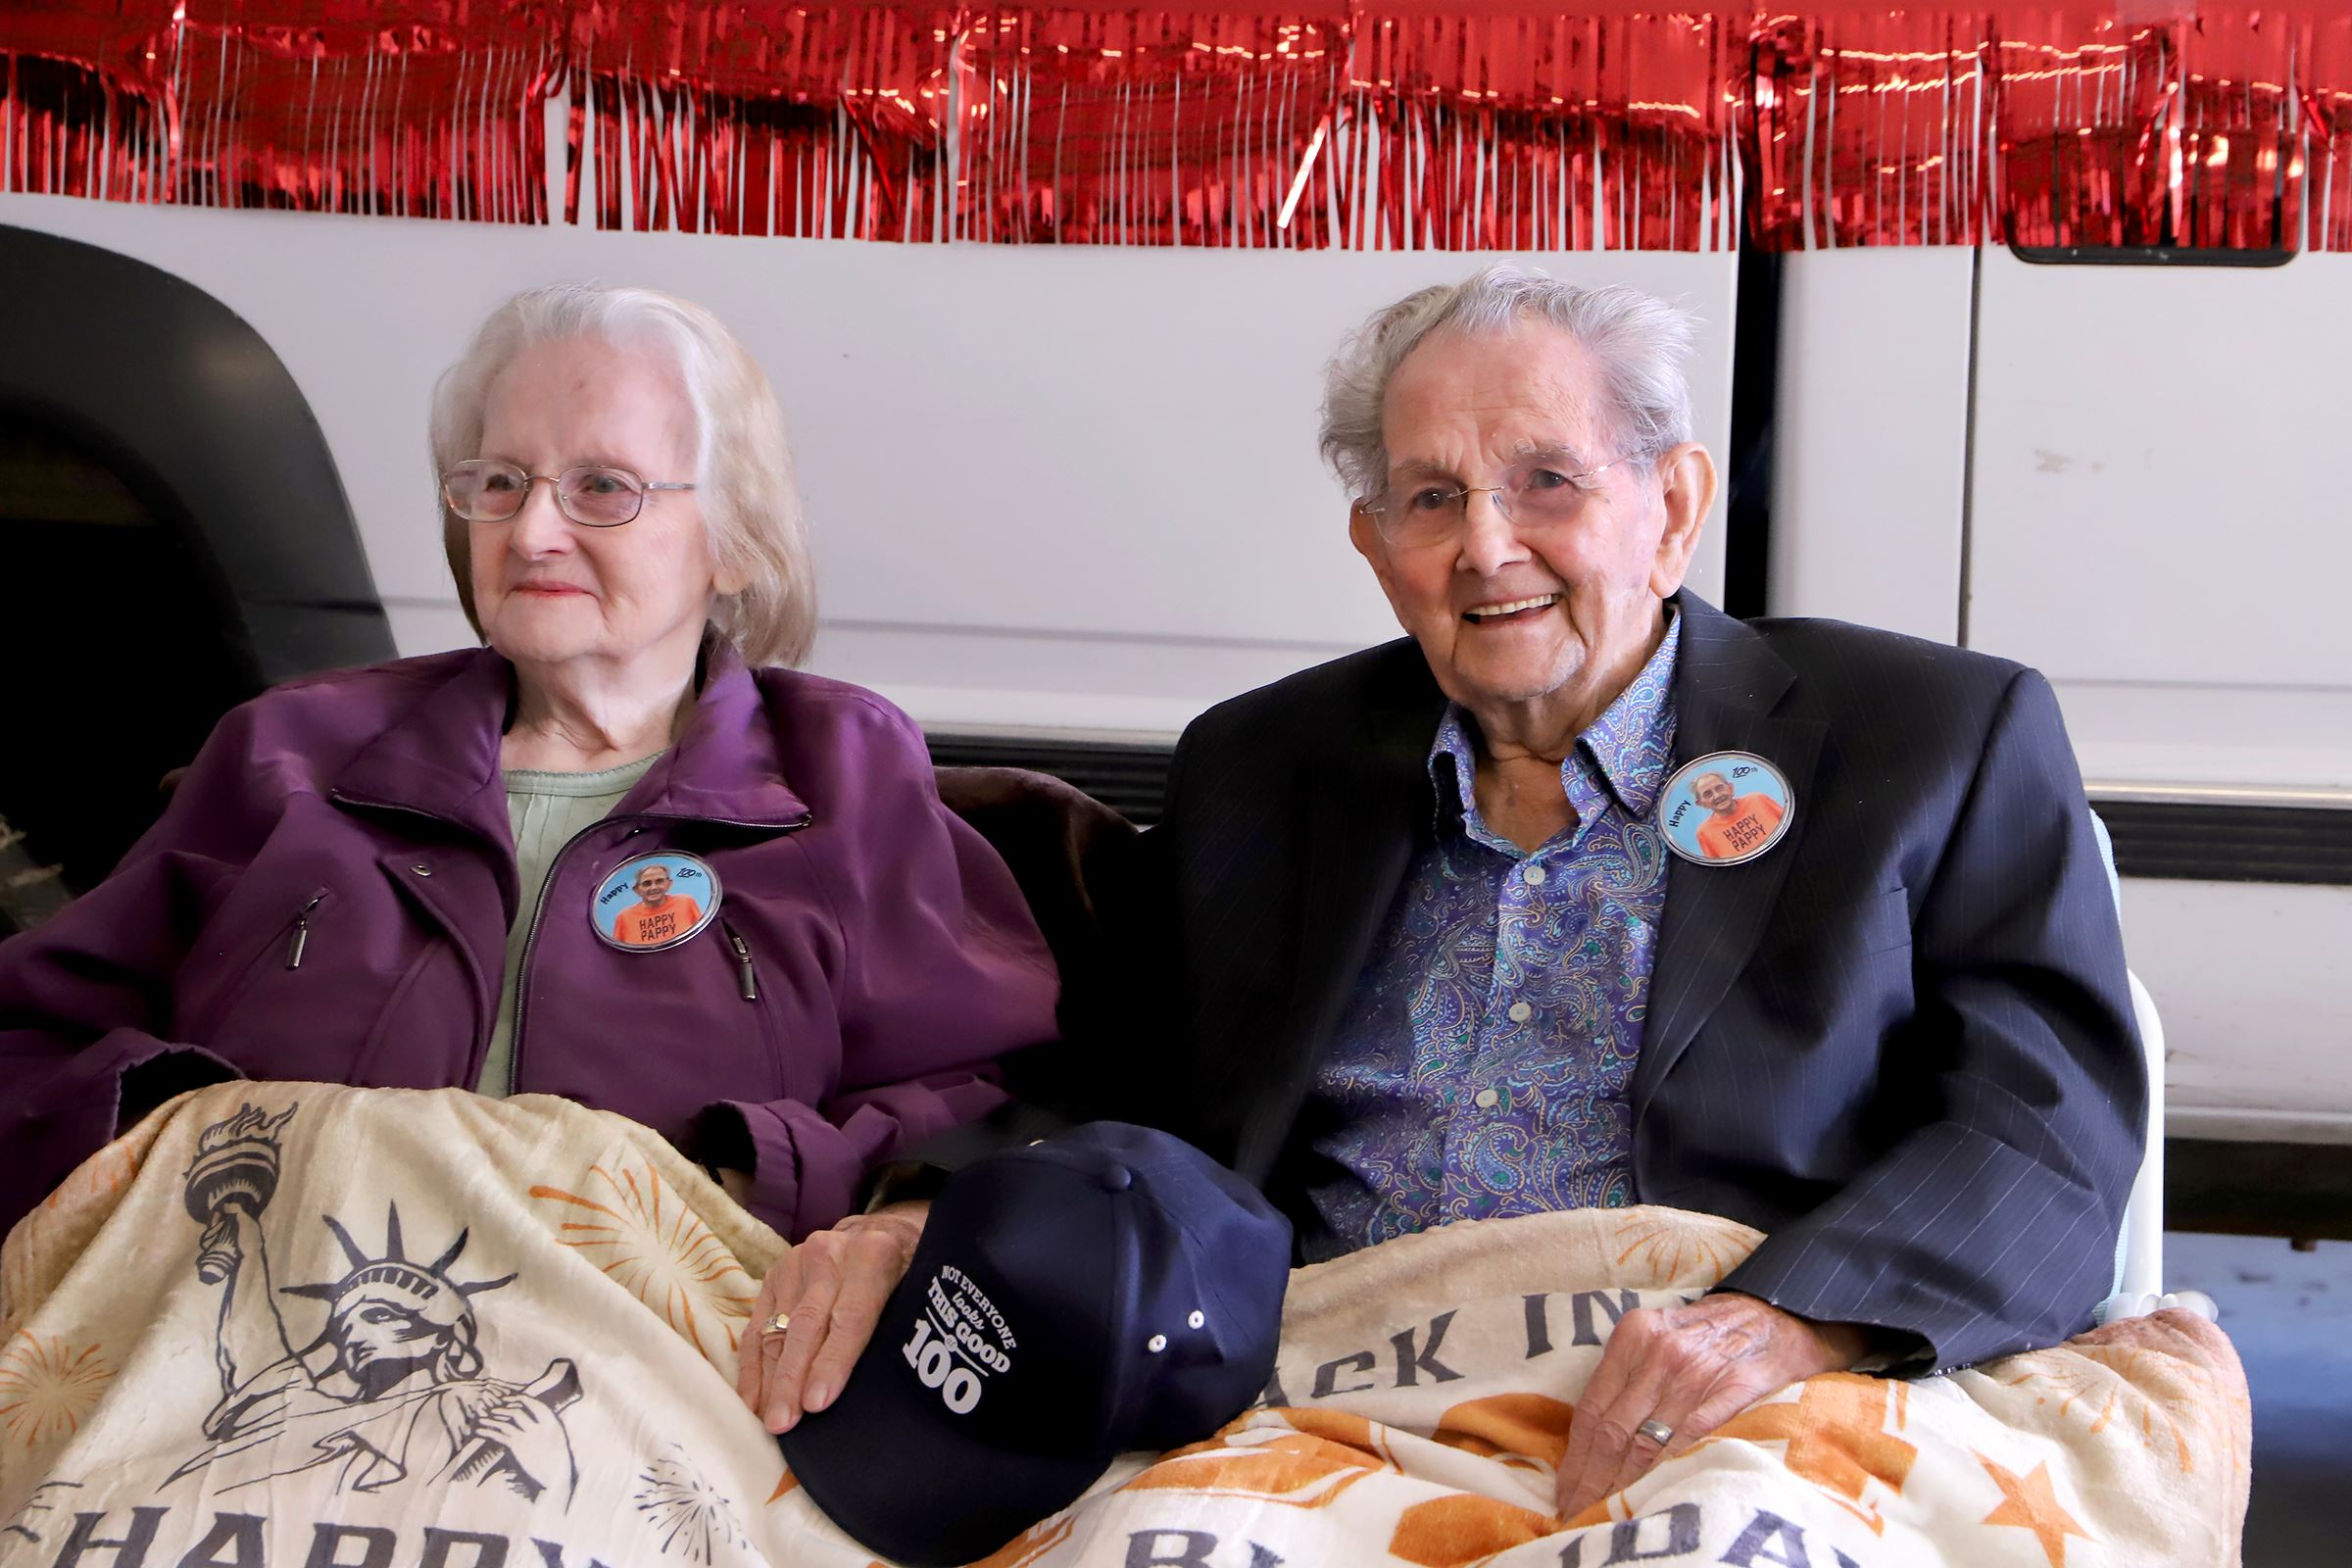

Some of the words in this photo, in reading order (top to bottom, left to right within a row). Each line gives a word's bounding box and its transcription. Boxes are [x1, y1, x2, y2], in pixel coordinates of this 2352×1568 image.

[1668, 799, 1691, 827] Happy
[1723, 813, 1759, 841] HAPPY
[1732, 824, 1766, 852] PAPPY
[600, 882, 629, 905] Happy
[639, 912, 675, 931] HAPPY
[641, 923, 676, 941] PAPPY
[941, 1265, 961, 1284] NOT
[959, 1275, 1017, 1349] EVERYONE
[927, 1276, 959, 1328] THIS
[956, 1321, 1010, 1373] GOOD
[902, 1319, 982, 1414] 100
